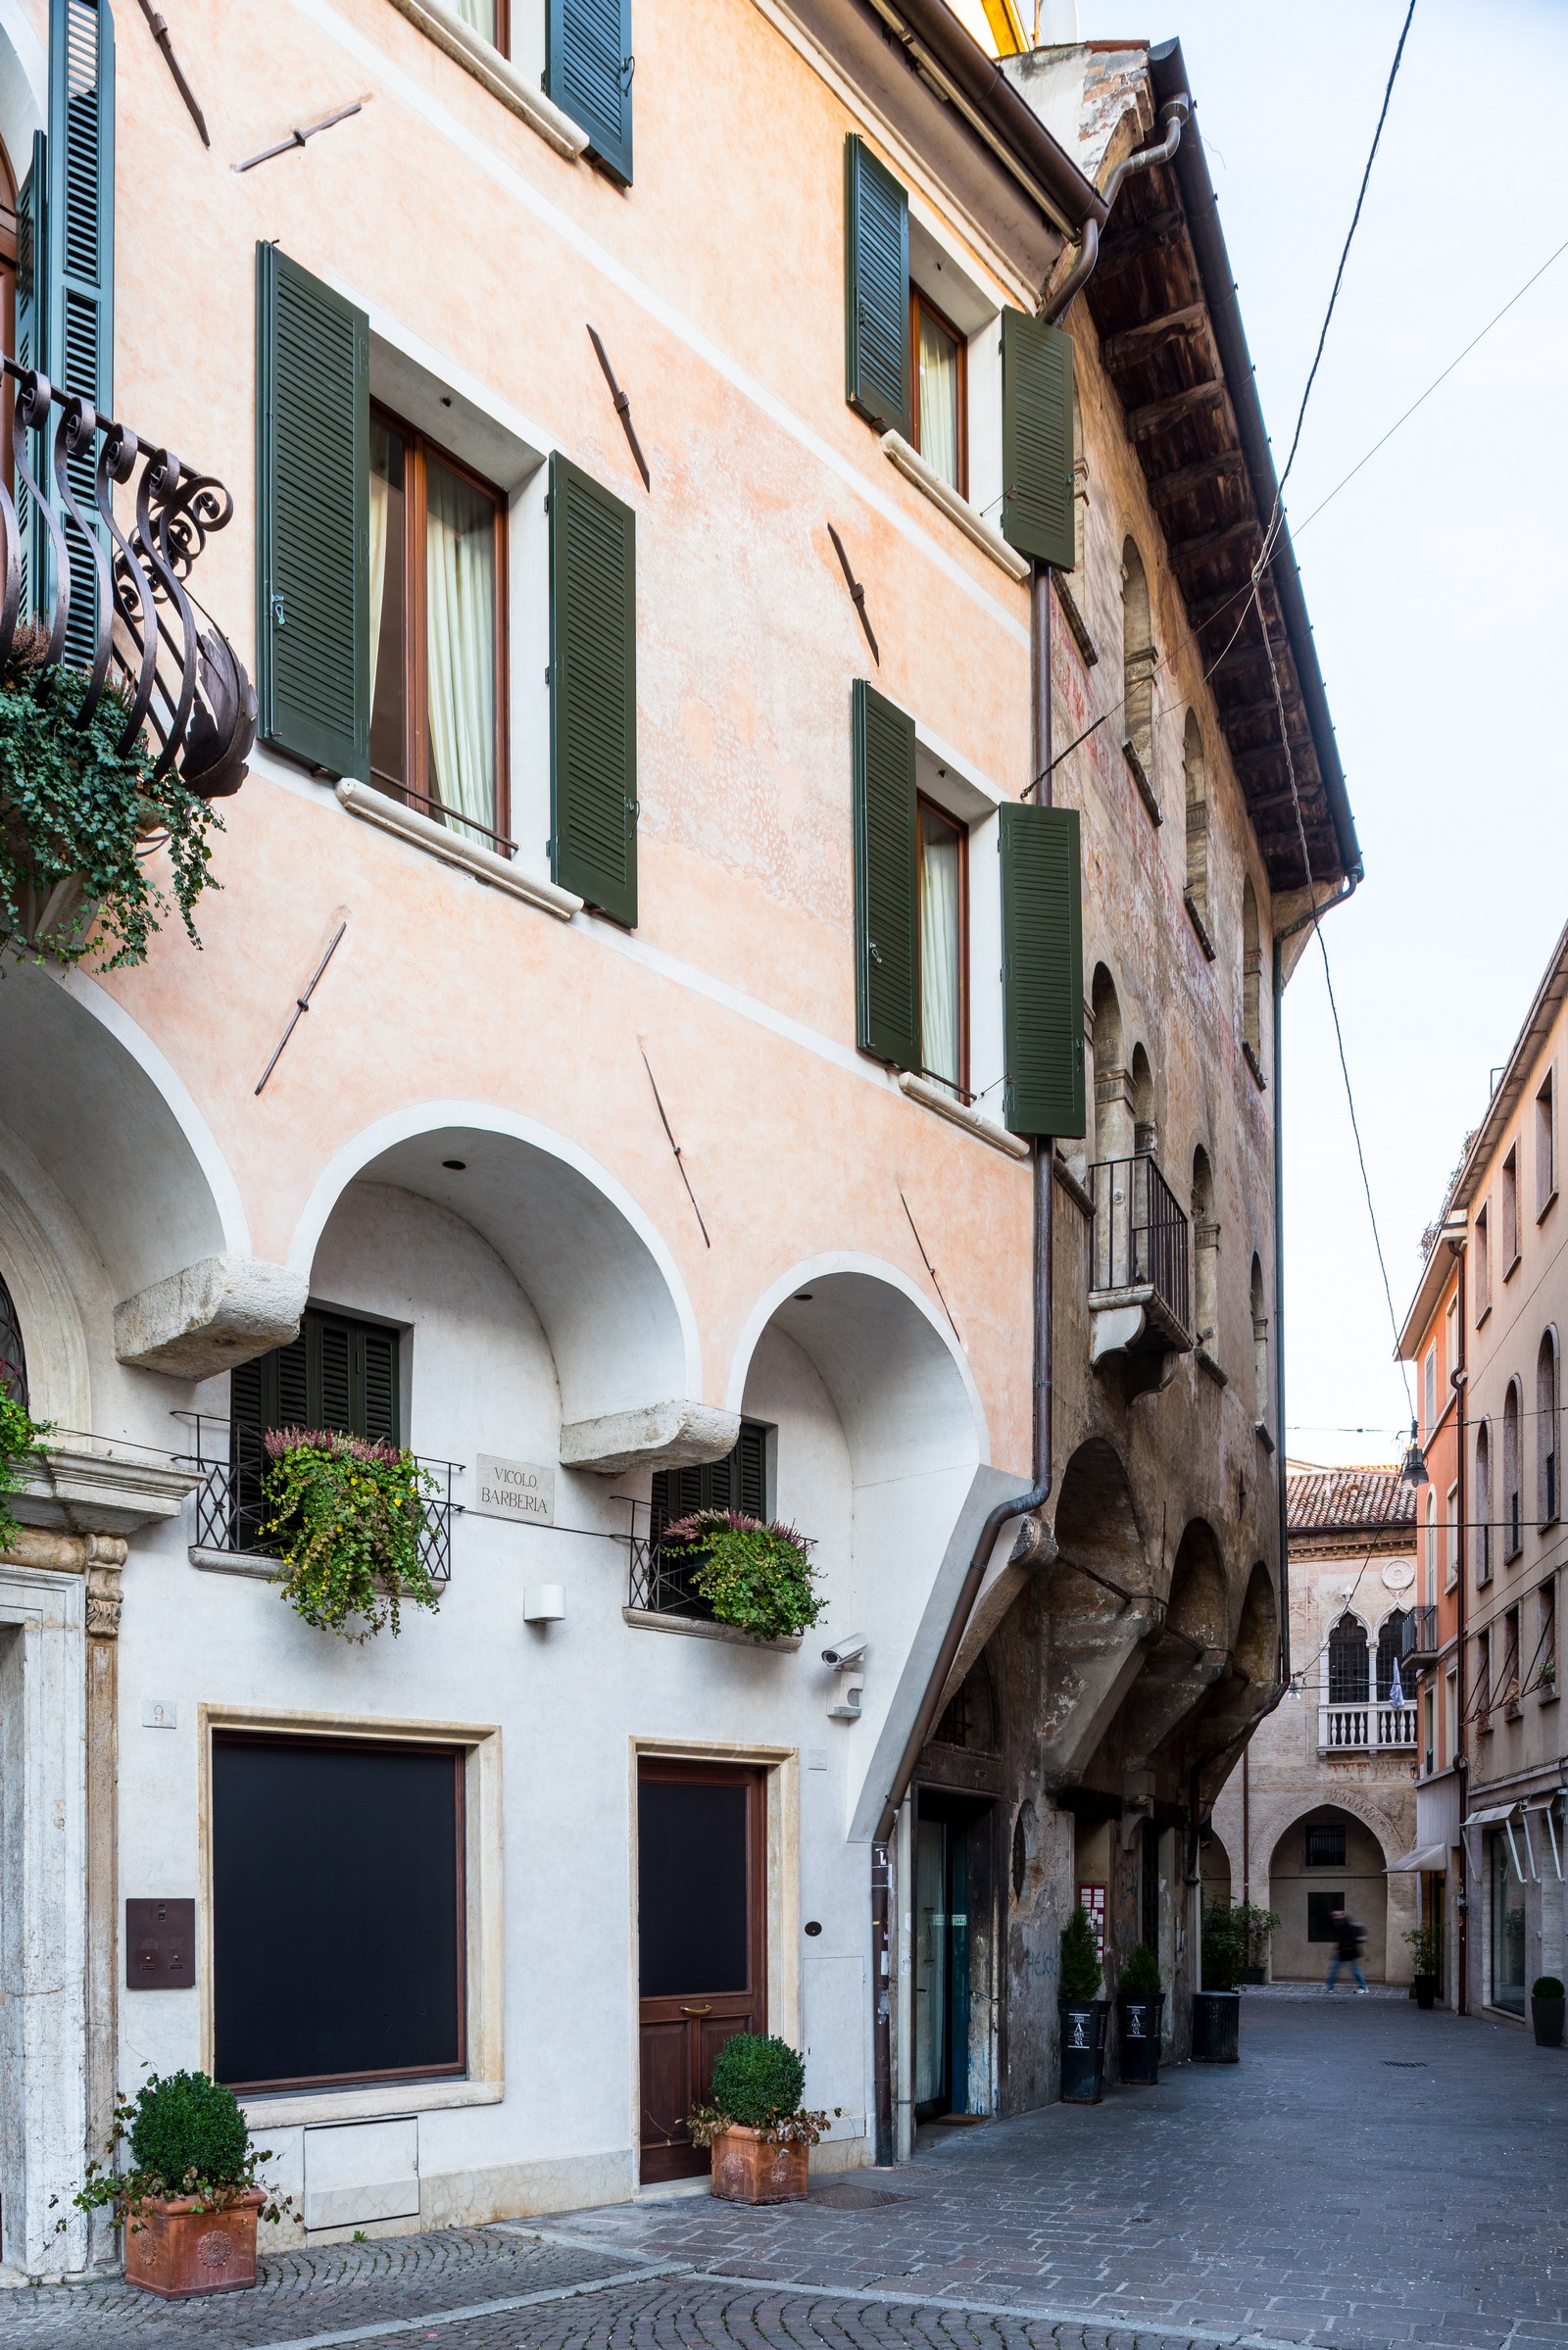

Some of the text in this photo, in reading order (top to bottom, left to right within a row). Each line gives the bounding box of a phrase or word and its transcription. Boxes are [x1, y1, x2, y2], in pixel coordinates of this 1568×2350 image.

[495, 1468, 537, 1488] VICOLO
[482, 1487, 547, 1513] BARBERIA
[154, 1704, 164, 1721] 9
[1074, 2023, 1083, 2032] A
